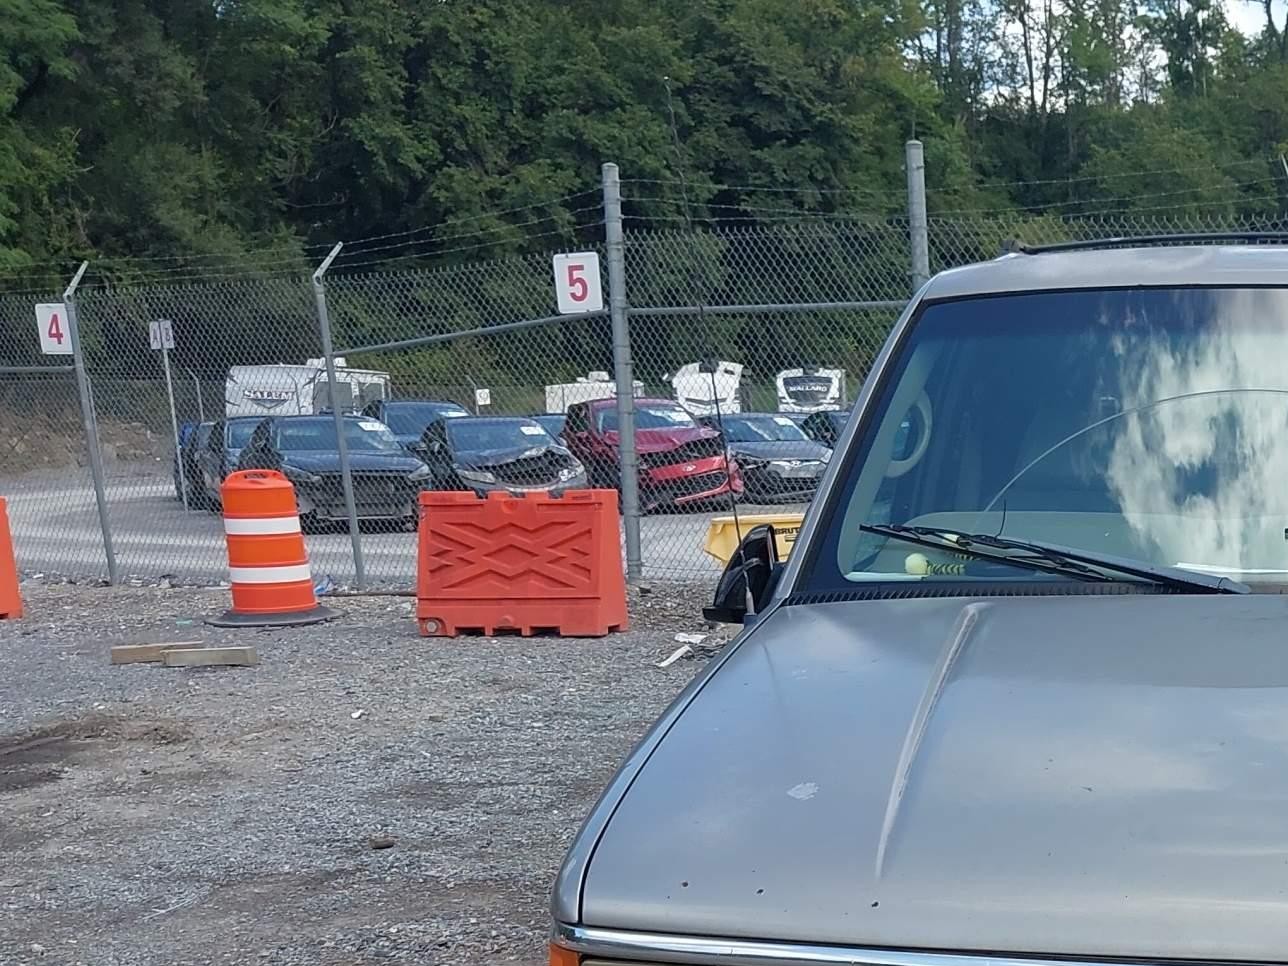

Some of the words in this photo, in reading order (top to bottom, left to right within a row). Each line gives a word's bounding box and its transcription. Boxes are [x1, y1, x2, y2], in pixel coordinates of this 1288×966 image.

[567, 264, 588, 302] 5
[48, 313, 64, 345] 4
[243, 389, 293, 400] SALEM
